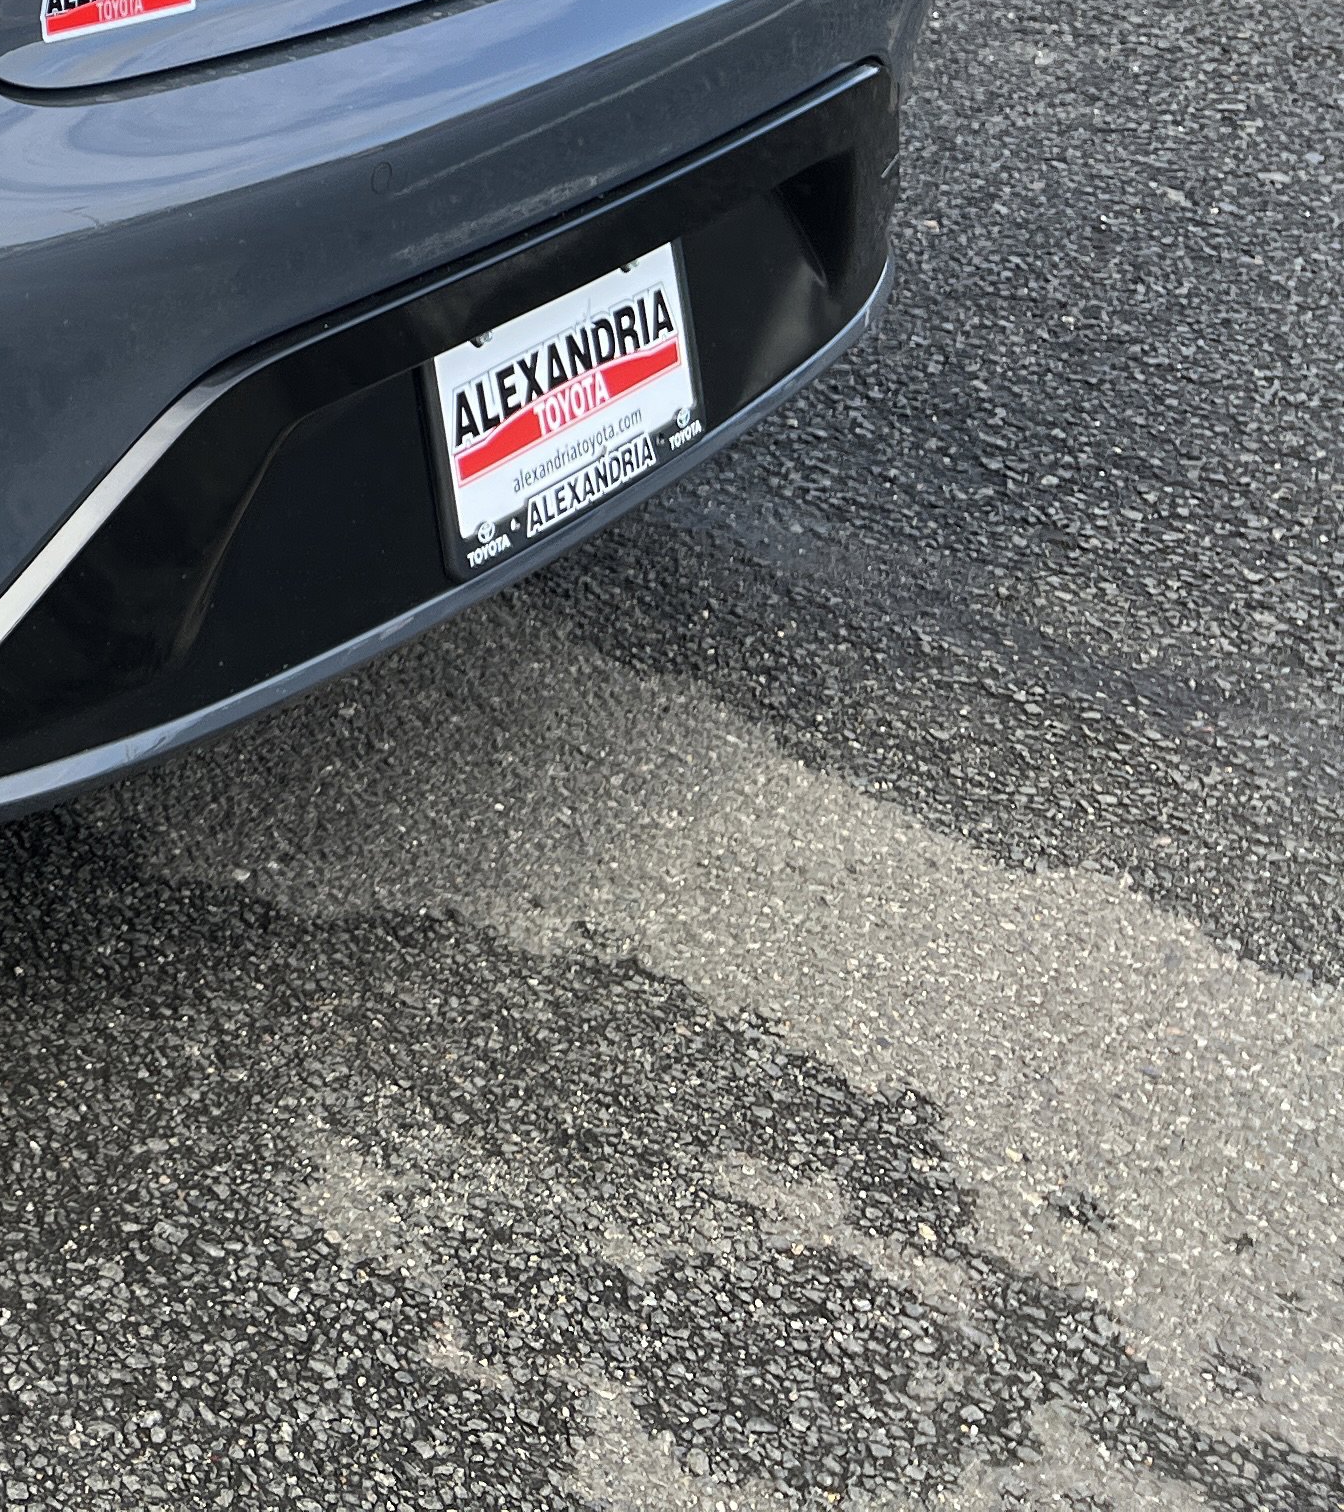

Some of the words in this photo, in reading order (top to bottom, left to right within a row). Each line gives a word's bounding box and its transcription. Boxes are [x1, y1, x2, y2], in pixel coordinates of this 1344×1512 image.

[454, 289, 674, 447] ALEXANDRIA
[534, 372, 610, 436] TOYOTA
[512, 408, 643, 492] alexandriatoyota.com
[668, 420, 702, 451] TOYOTA
[528, 435, 655, 535] ALEXANDRIA
[467, 534, 511, 568] TOYOTA
